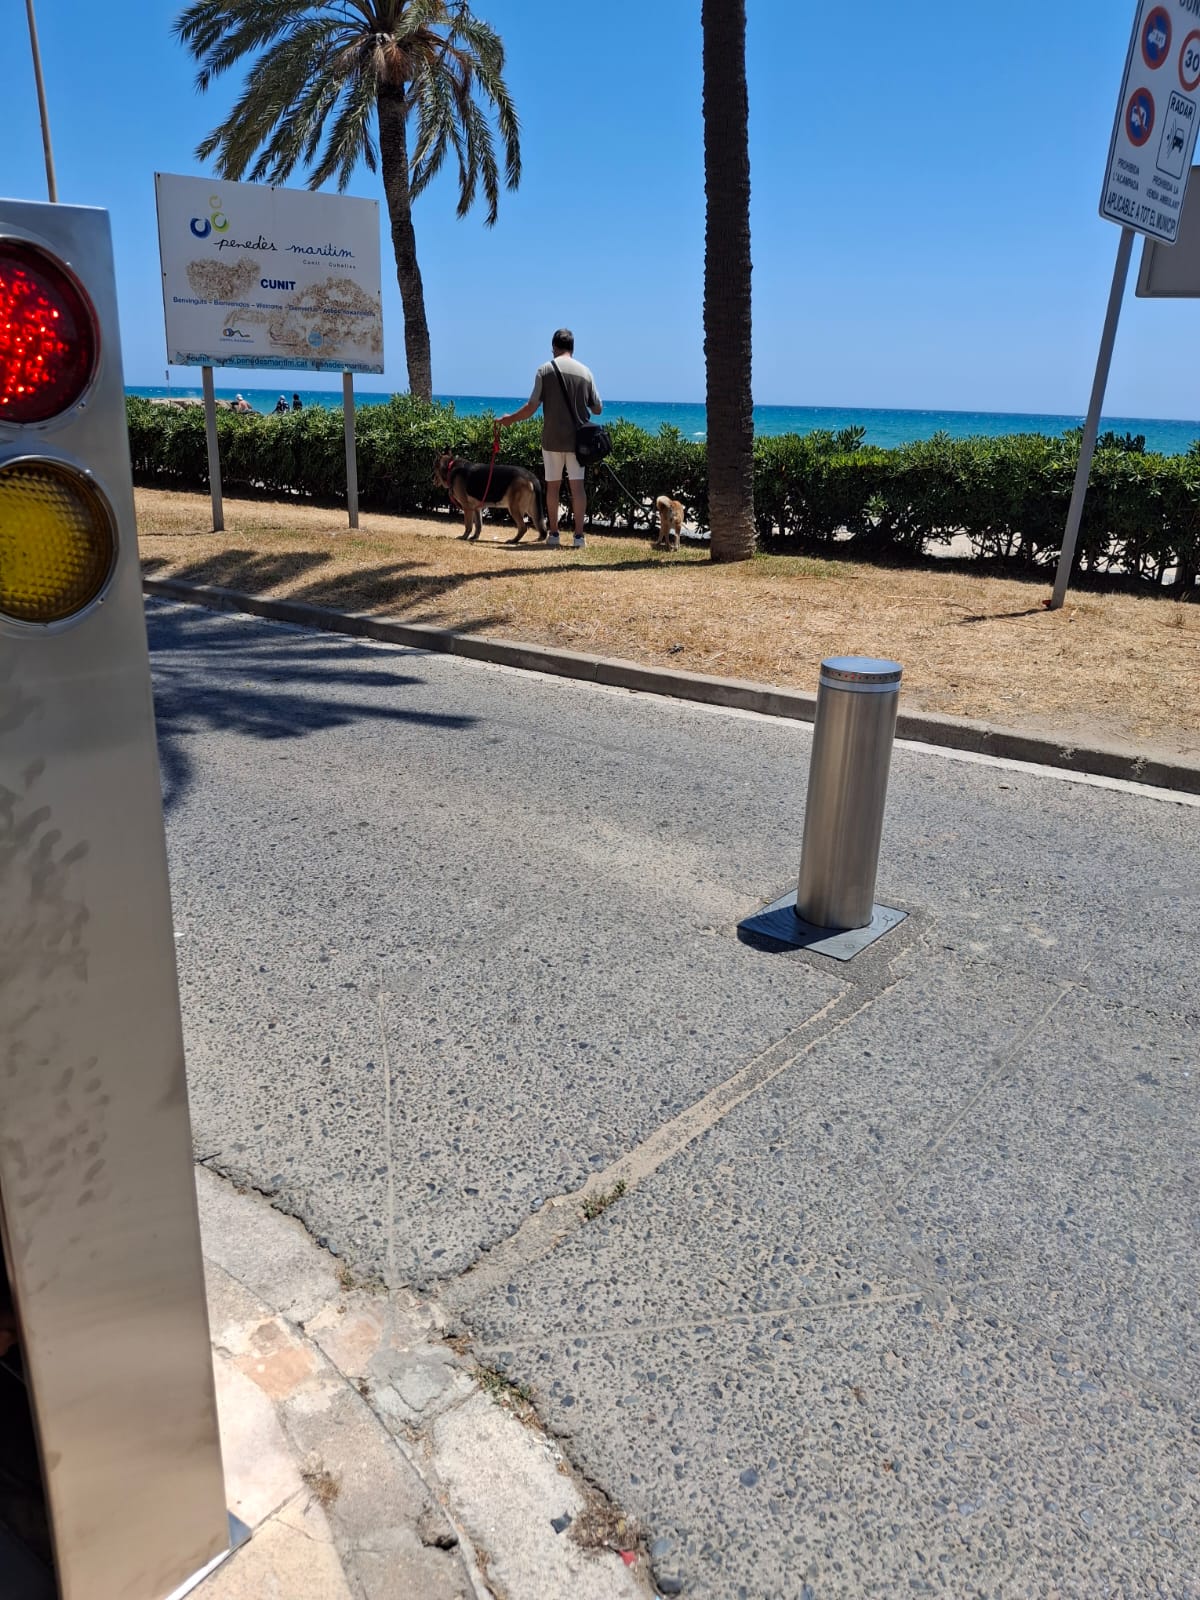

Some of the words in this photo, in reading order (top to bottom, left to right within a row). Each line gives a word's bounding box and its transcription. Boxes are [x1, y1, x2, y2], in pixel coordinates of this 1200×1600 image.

[1185, 49, 1200, 72] 30
[1170, 97, 1193, 121] RADAR
[1172, 184, 1179, 195] LA
[1107, 191, 1136, 218] APLICABLE
[1134, 203, 1141, 222] A
[1141, 205, 1151, 224] TOT
[1149, 209, 1156, 227] EL
[213, 235, 278, 251] penedès
[260, 278, 296, 291] CUNIT
[173, 296, 207, 306] Benvinguts
